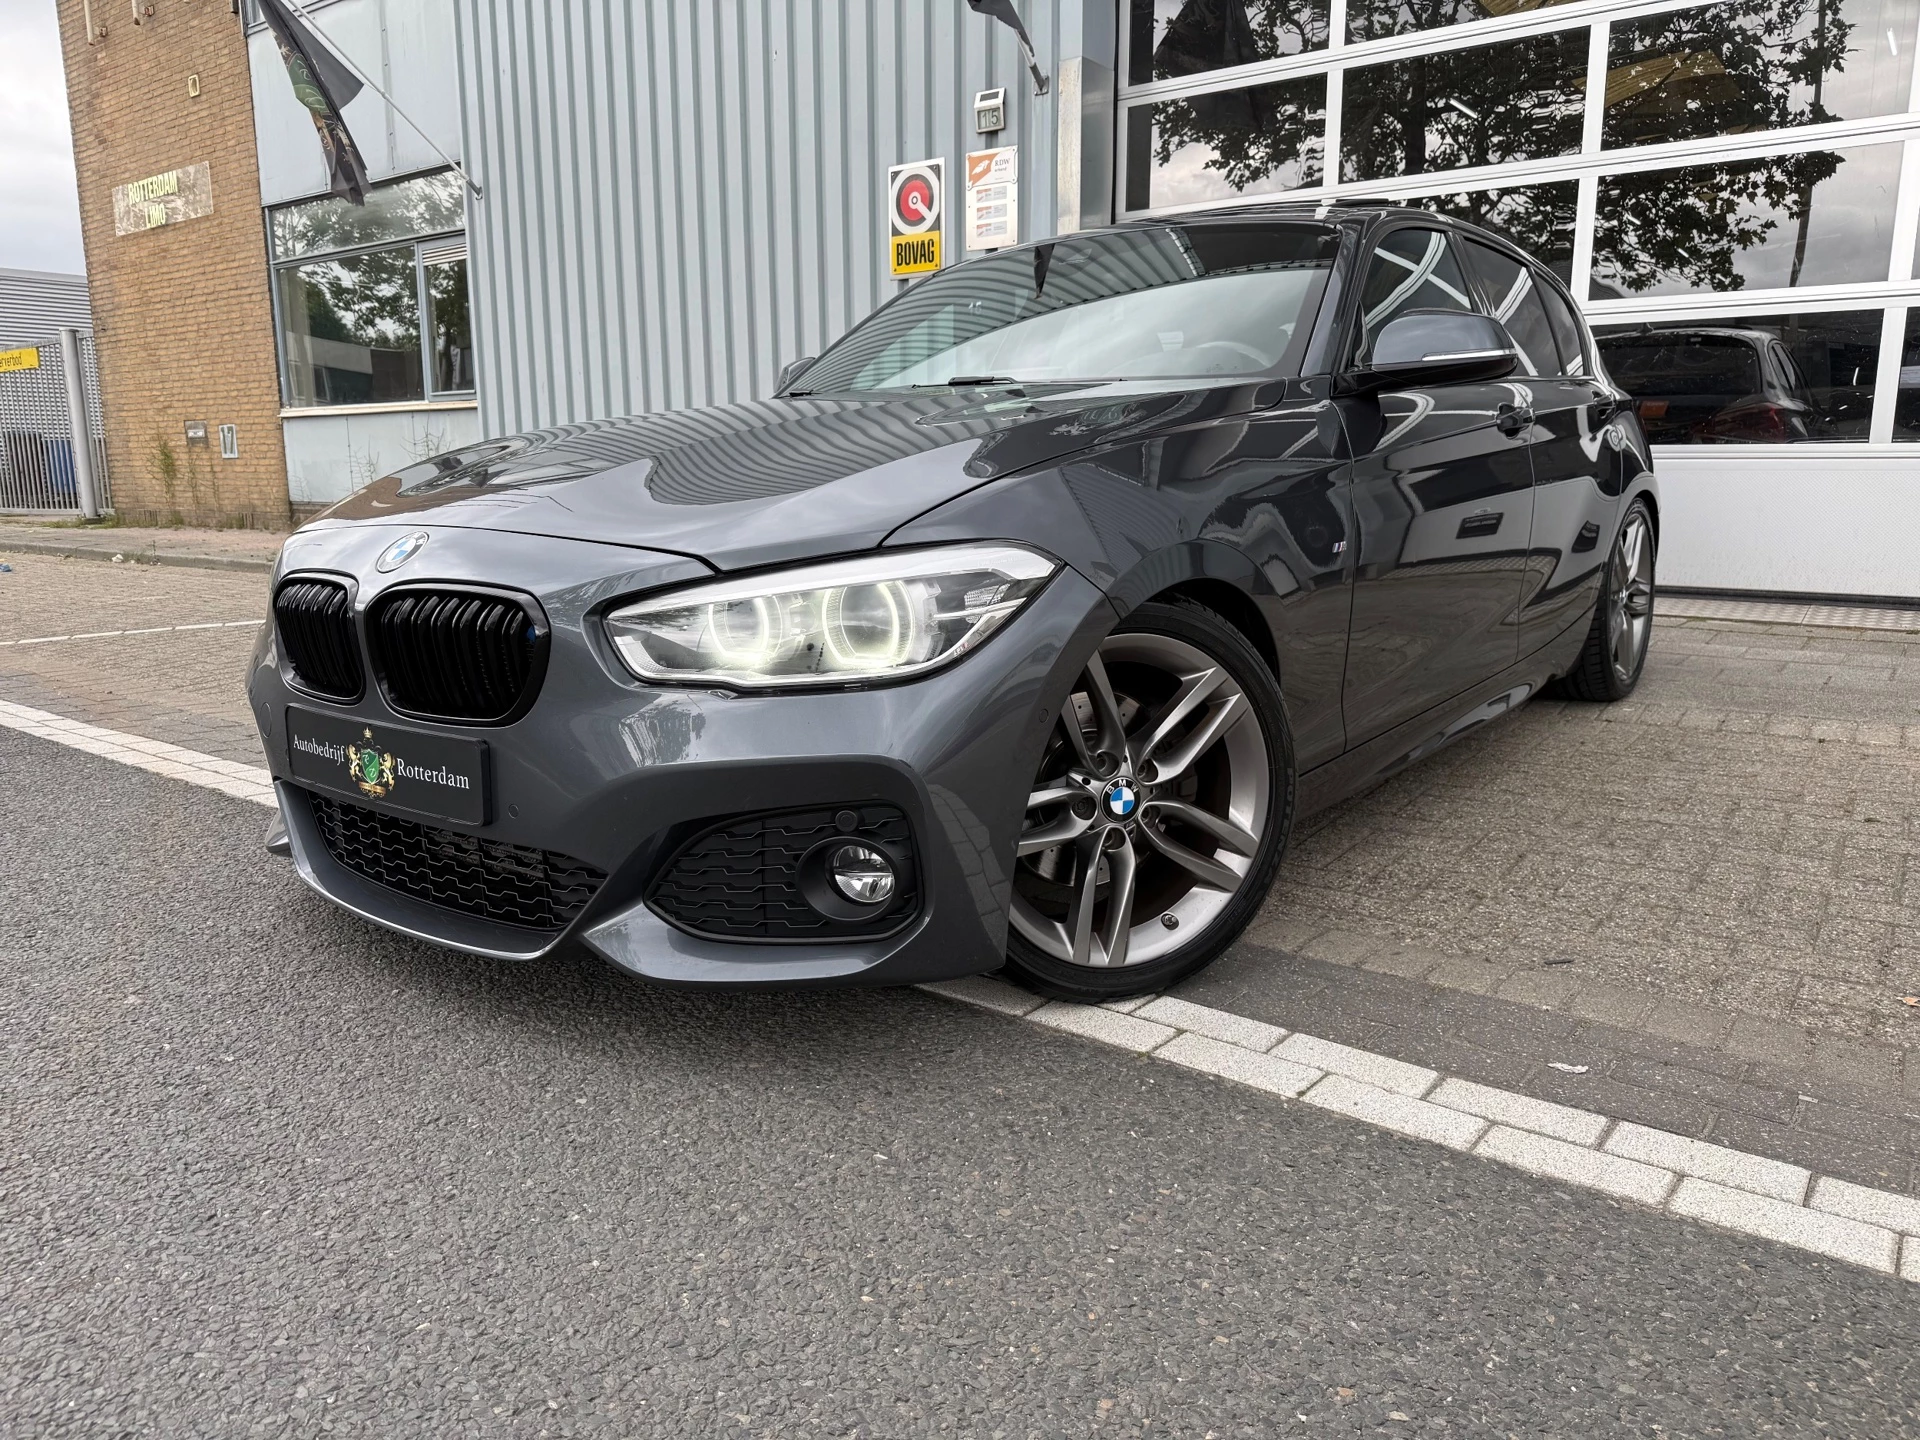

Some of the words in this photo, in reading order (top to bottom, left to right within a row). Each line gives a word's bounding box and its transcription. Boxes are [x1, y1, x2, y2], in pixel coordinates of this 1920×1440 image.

[982, 109, 999, 128] 15
[128, 170, 178, 204] ROTTERDAM
[145, 203, 166, 228] LIMO
[896, 238, 935, 267] BOVAG
[293, 734, 346, 766] Autobedrijf
[397, 757, 470, 790] Rotterdam
[1106, 779, 1139, 795] BMW
